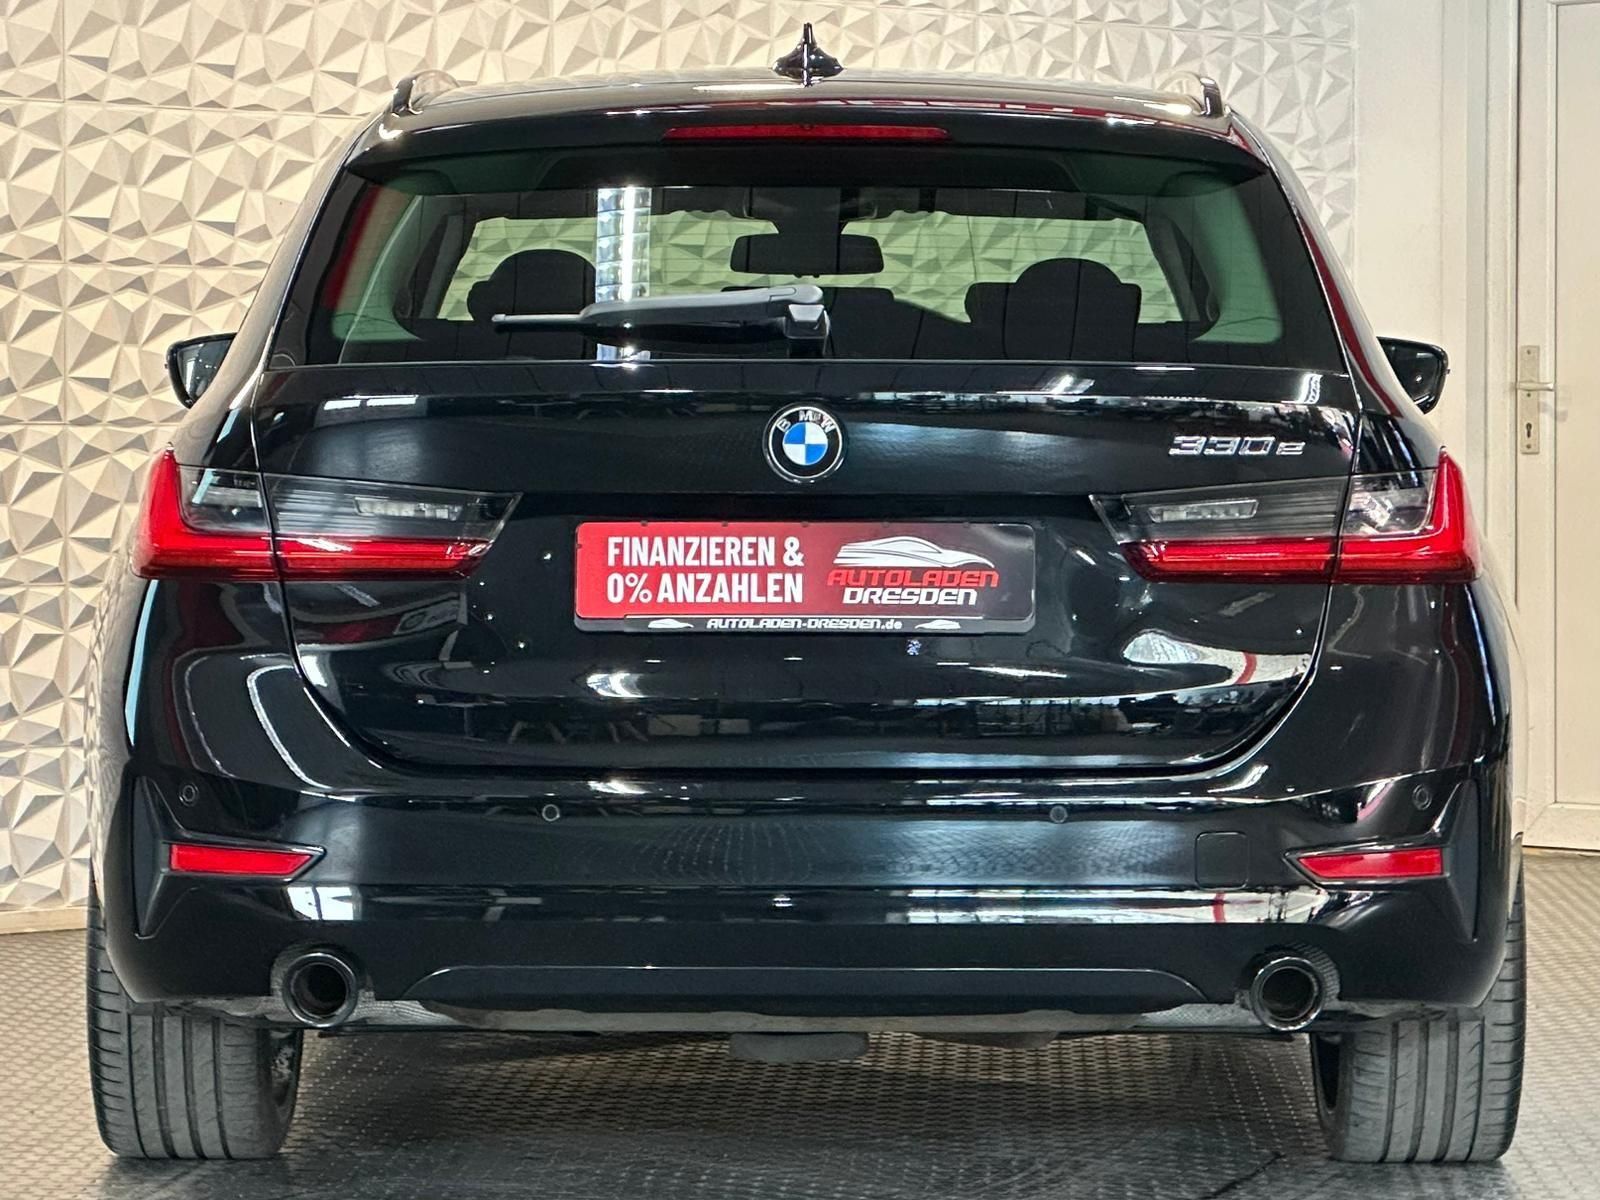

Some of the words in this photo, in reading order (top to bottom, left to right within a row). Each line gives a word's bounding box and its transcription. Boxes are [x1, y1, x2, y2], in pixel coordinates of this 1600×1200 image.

[776, 410, 836, 433] BMW
[607, 536, 775, 566] FINANZIEREN
[783, 536, 805, 566] &
[607, 573, 653, 603] 0%
[656, 573, 803, 603] ANZAHLEN
[827, 569, 999, 587] AUTOLADEN
[842, 588, 978, 605] DRESDEN
[706, 618, 903, 630] AUTOLADEN-DRESDEN.de
